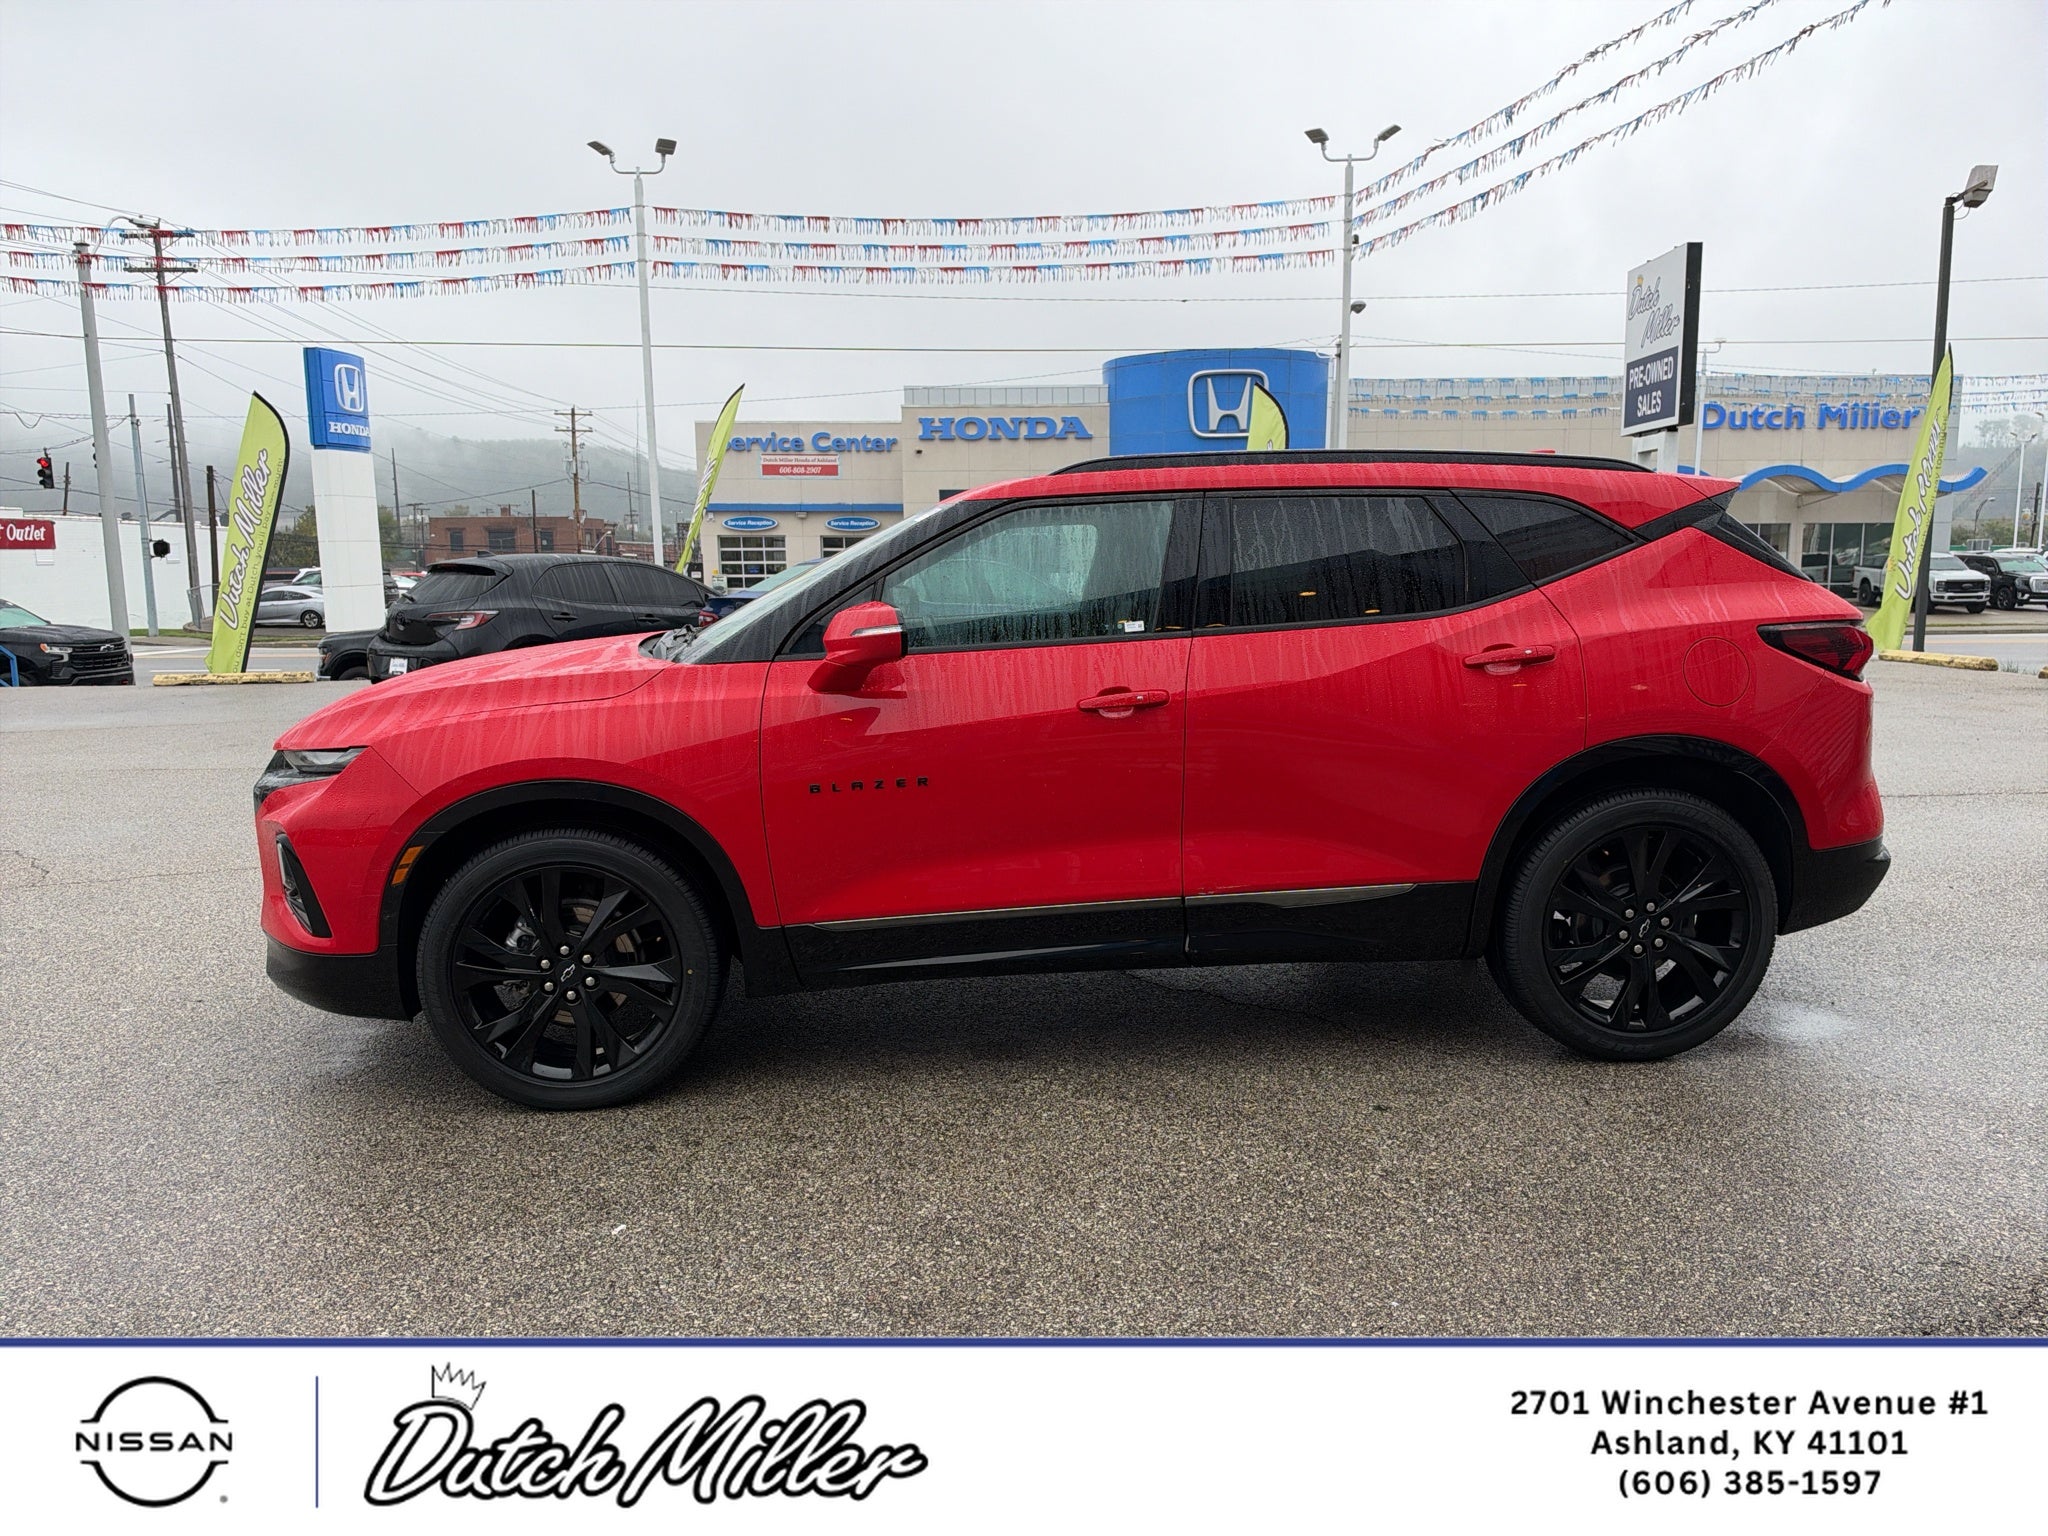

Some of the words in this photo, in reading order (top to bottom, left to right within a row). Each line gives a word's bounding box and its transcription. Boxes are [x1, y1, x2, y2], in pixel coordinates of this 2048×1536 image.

[1628, 277, 1661, 320] Dutch
[1641, 304, 1680, 348] Miller
[1629, 356, 1673, 391] PRE-OWNED
[1637, 390, 1662, 418] SALES
[1703, 402, 1805, 430] Dutch
[1818, 402, 1920, 430] Miller
[329, 421, 370, 437] HONDA
[918, 416, 1093, 440] HONDA
[726, 431, 804, 454] ervice
[811, 431, 898, 454] Center
[233, 448, 271, 550] Miller
[6, 523, 47, 542] Outlet
[727, 519, 747, 527] Service
[748, 519, 773, 528] Reception
[830, 519, 850, 527] Service
[850, 519, 876, 528] Reception
[809, 776, 929, 794] BLAZER
